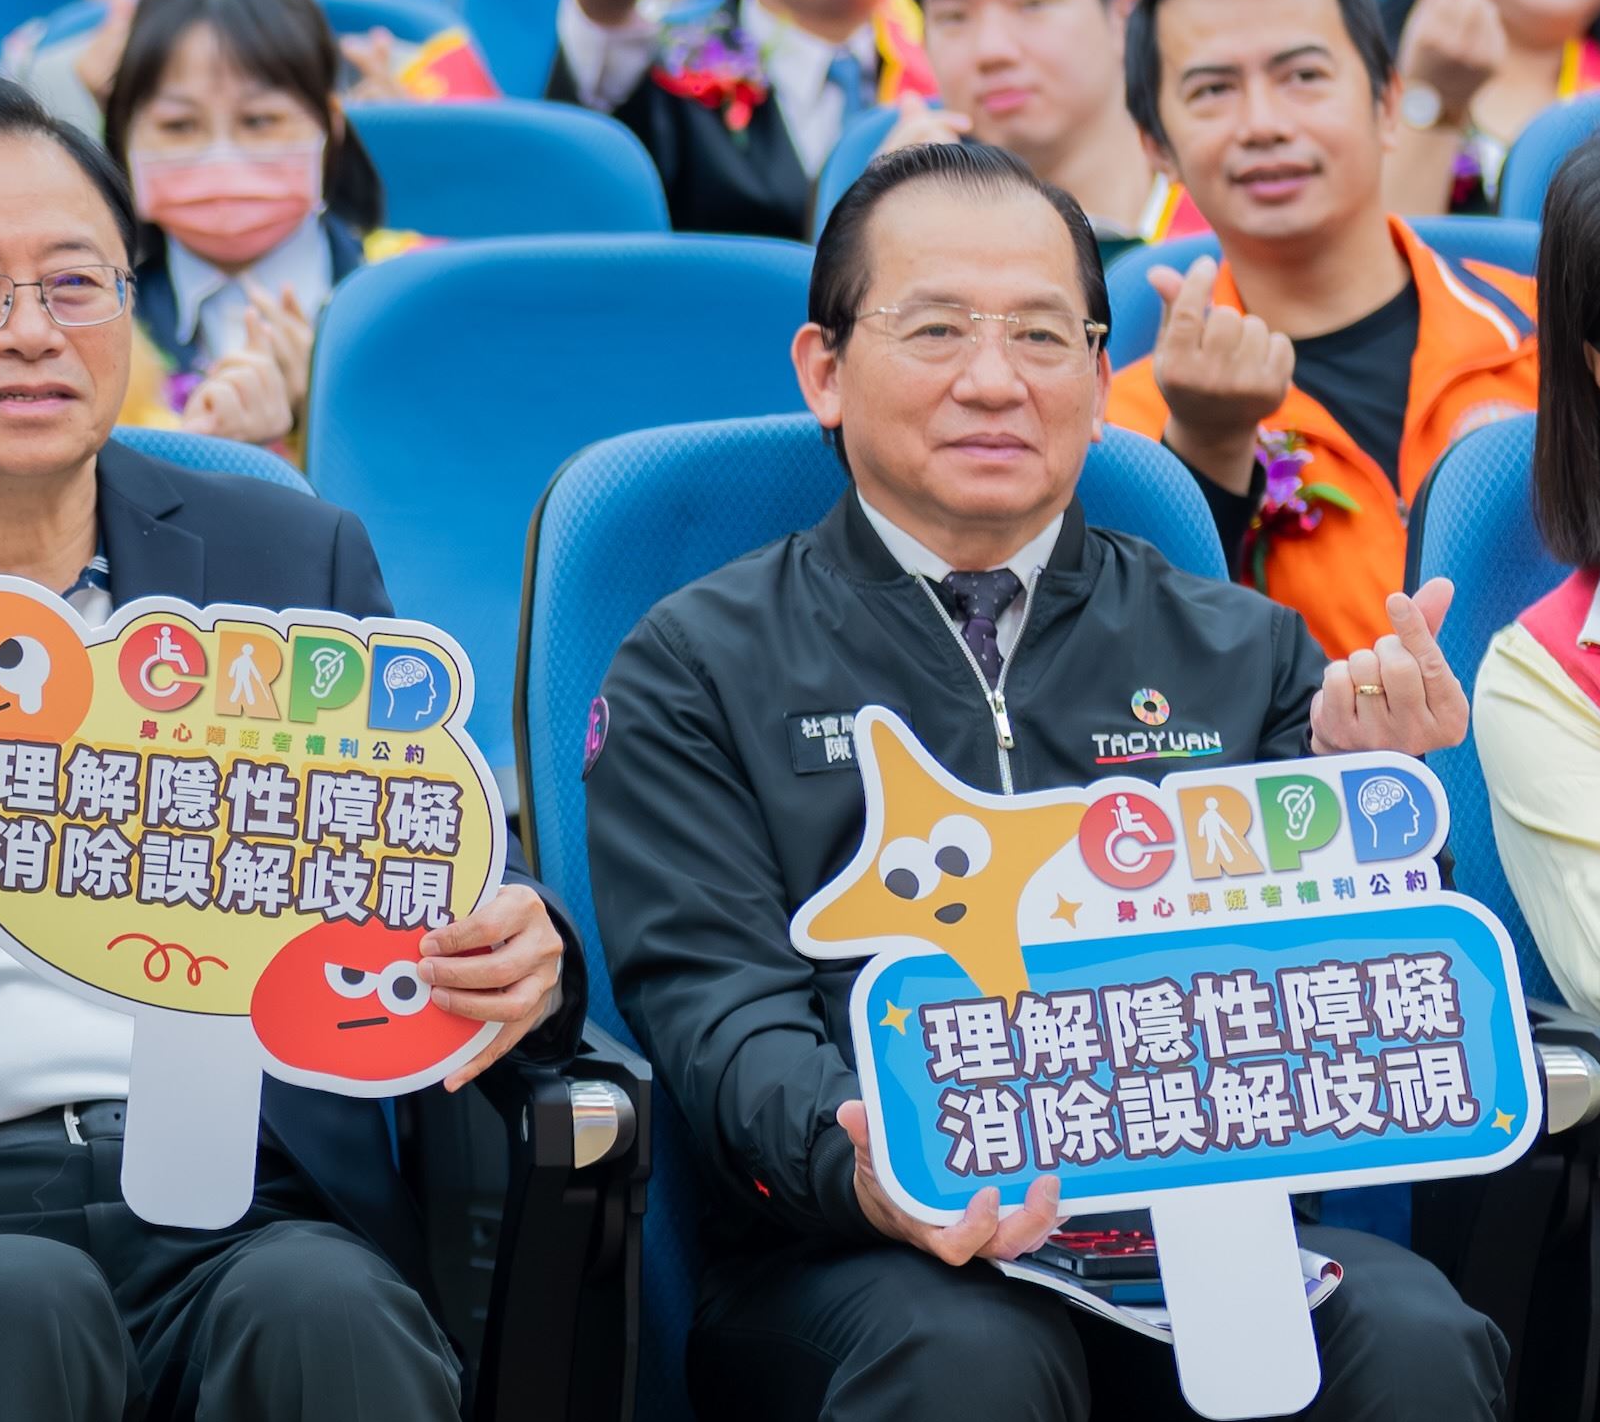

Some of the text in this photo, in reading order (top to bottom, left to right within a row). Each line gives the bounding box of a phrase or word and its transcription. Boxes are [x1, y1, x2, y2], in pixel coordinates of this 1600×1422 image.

[118, 622, 451, 732] CRPD
[140, 719, 425, 765] 身心障礙者權利公約
[1092, 731, 1222, 756] TAOYUAN
[1078, 767, 1438, 890] CRPD
[1116, 869, 1429, 924] 身心障礙者權利公約
[922, 953, 1462, 1084] 理解隱性障礙
[939, 1045, 1479, 1175] 消除誤解歧視
